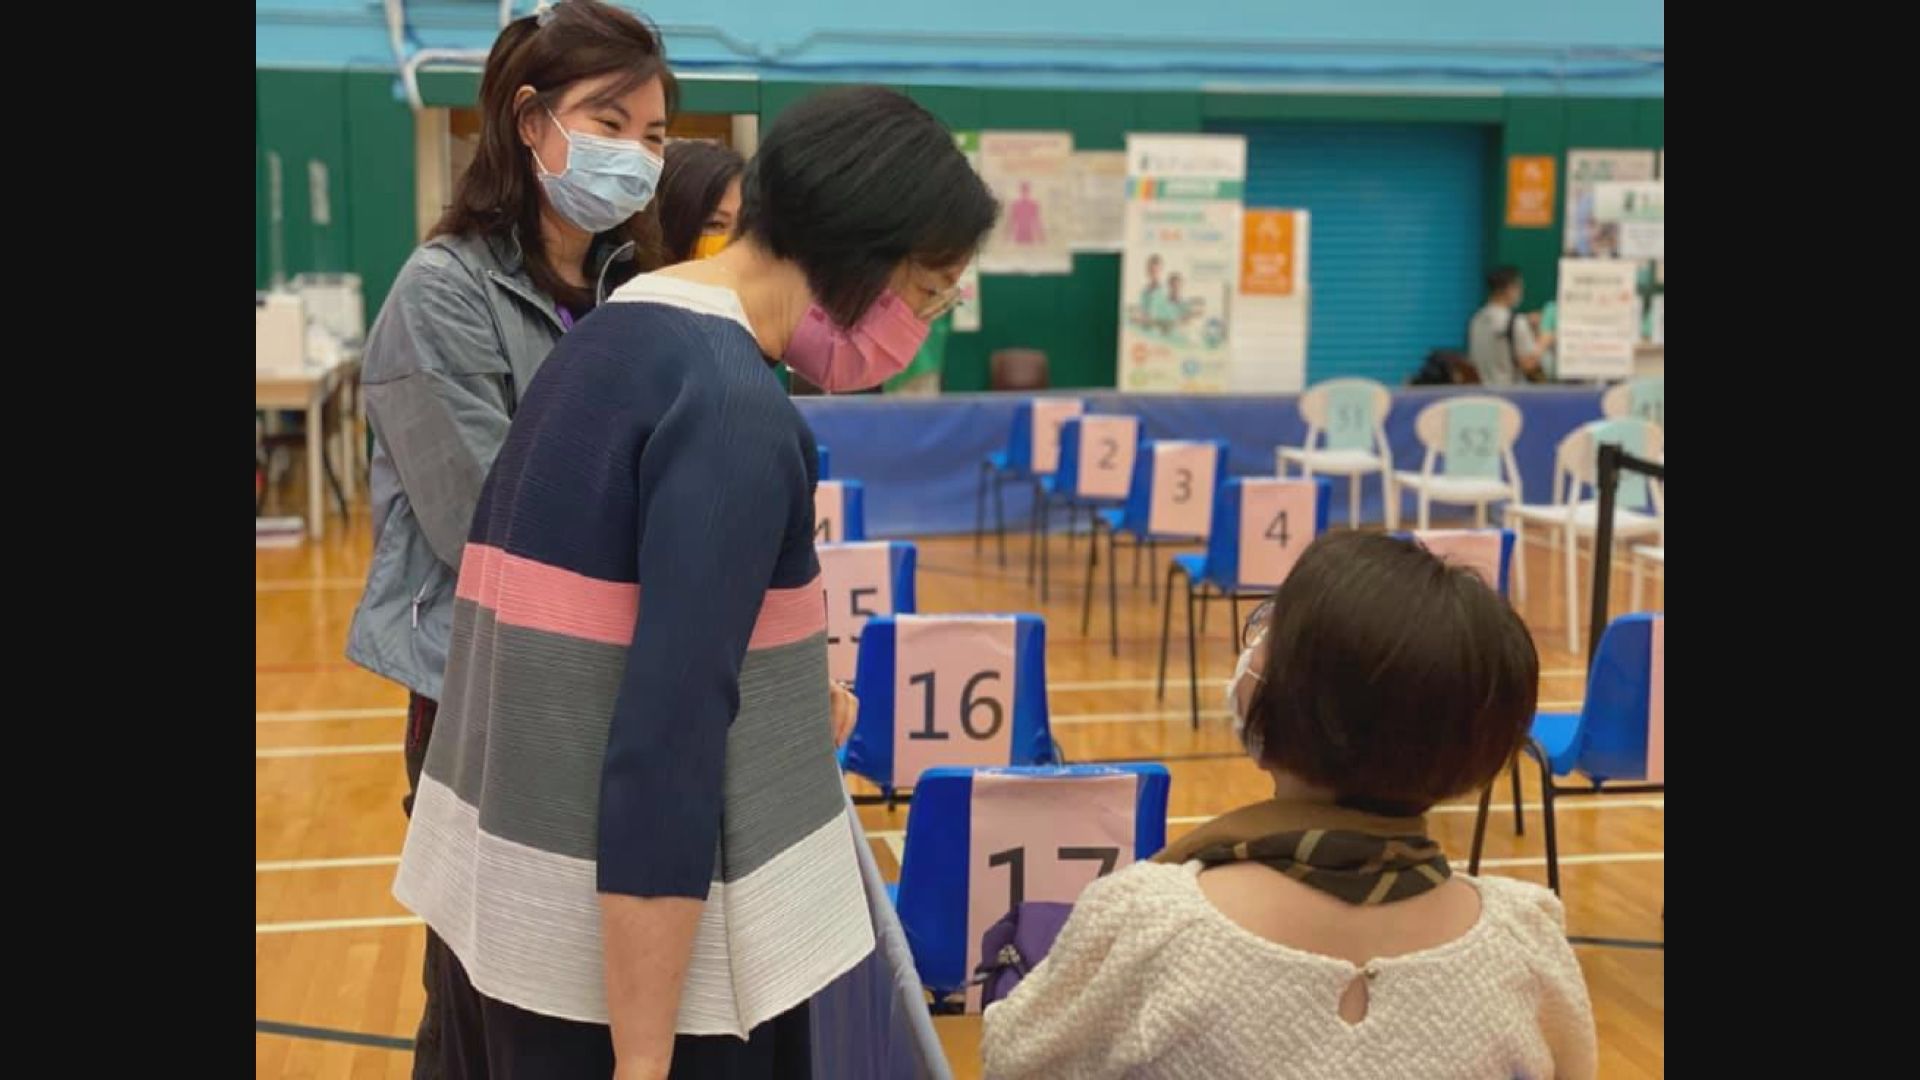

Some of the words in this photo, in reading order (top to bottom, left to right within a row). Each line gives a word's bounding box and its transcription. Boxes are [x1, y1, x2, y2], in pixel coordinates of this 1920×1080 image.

[1099, 438, 1118, 470] 2
[1459, 427, 1493, 459] 52
[1171, 469, 1193, 504] 3
[1264, 510, 1292, 548] 4
[908, 668, 1004, 741] 16
